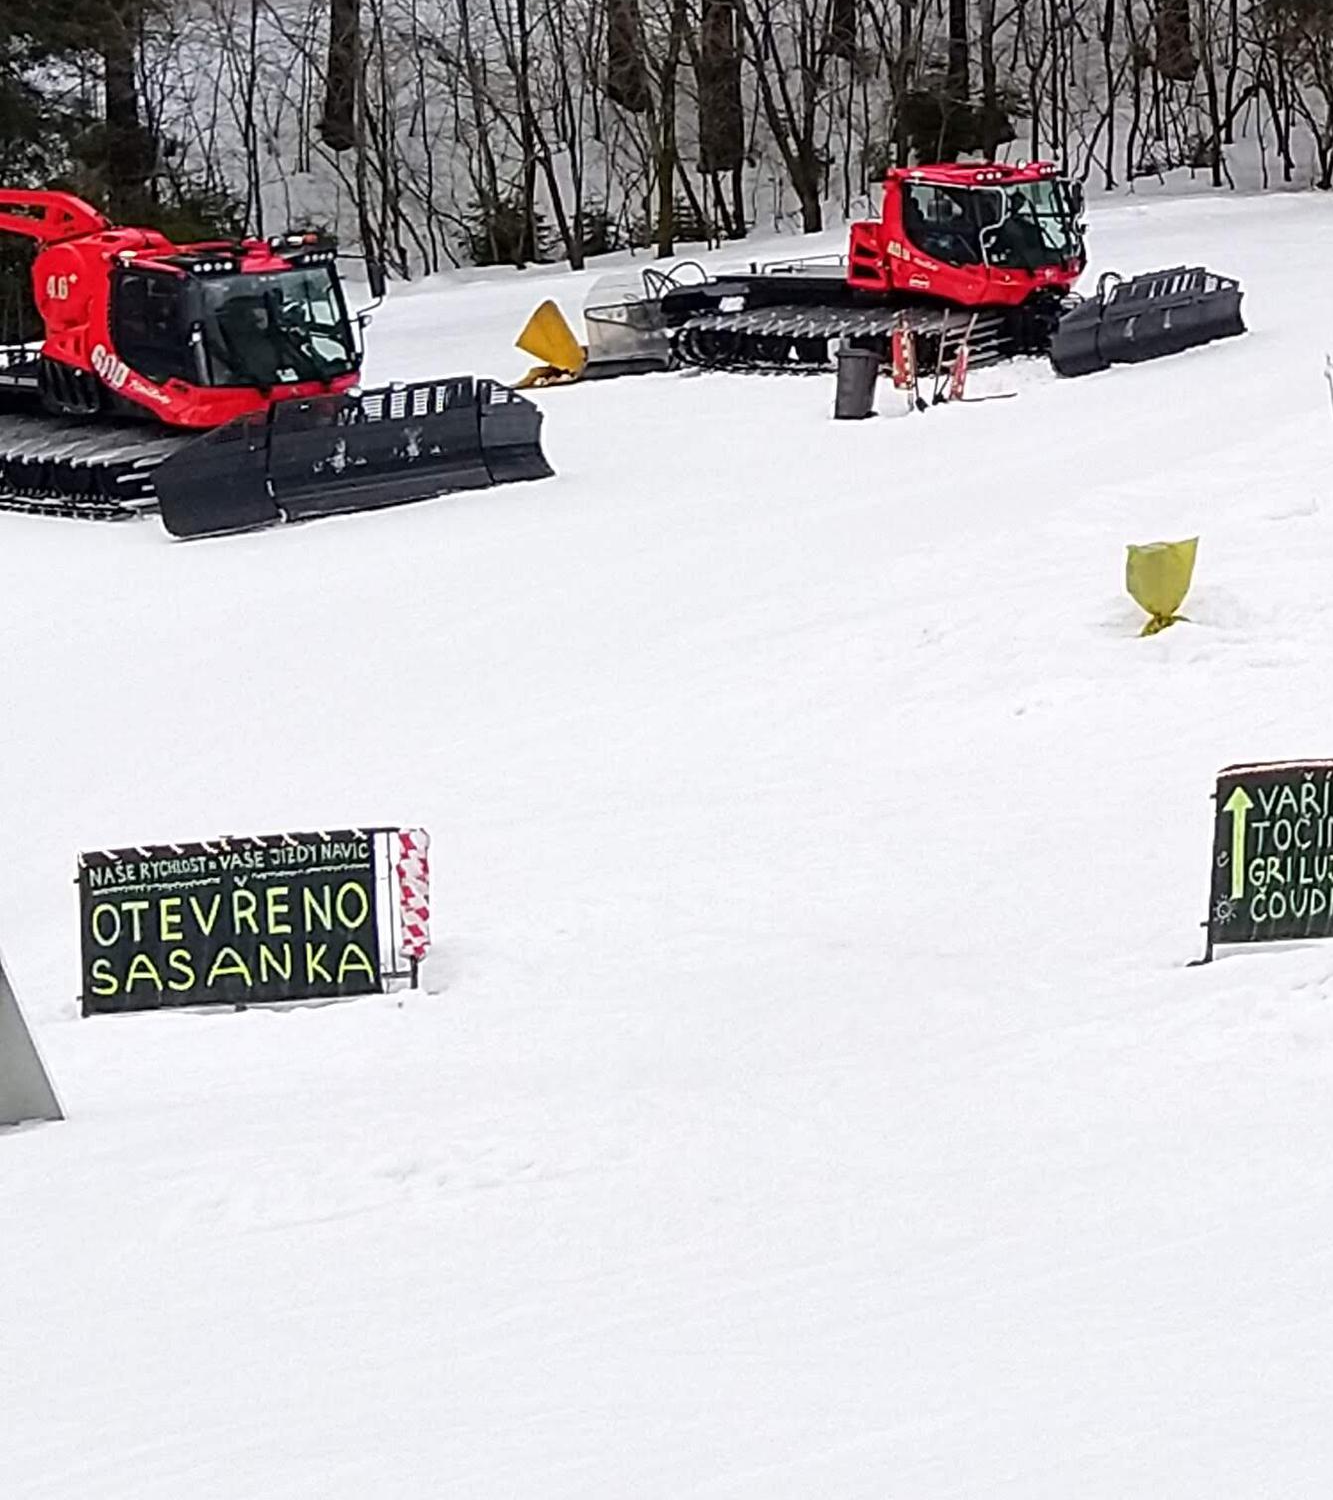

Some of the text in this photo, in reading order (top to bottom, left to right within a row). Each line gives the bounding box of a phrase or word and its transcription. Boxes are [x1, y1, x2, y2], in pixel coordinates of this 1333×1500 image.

[89, 858, 135, 887] NAŠE
[139, 856, 207, 881] RYCHLOST
[219, 843, 265, 870] VAŠE
[91, 875, 370, 947] OTEVŘENO
[91, 942, 376, 996] SASANKA
